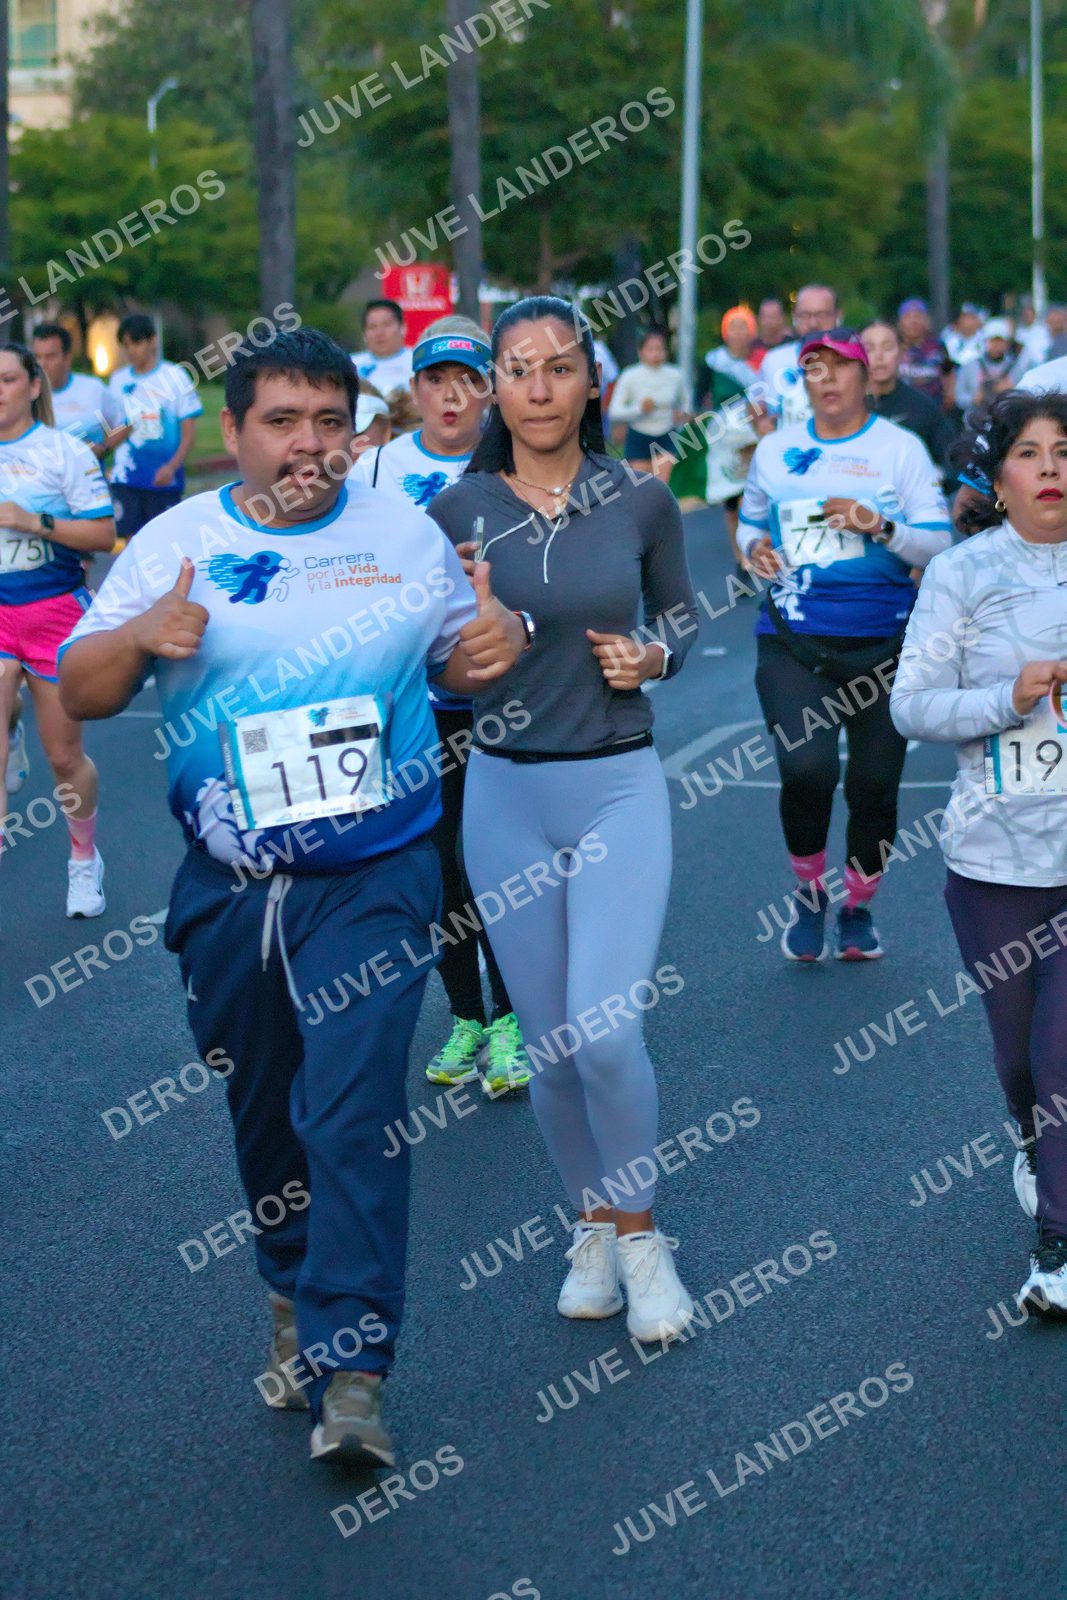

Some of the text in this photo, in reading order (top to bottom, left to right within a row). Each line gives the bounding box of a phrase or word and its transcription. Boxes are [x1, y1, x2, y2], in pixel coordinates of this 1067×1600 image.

[304, 552, 375, 569] Carrera
[306, 562, 379, 582] por la Vida
[307, 573, 402, 594] y la Integridad
[1008, 739, 1063, 782] 19
[271, 747, 369, 807] 119
